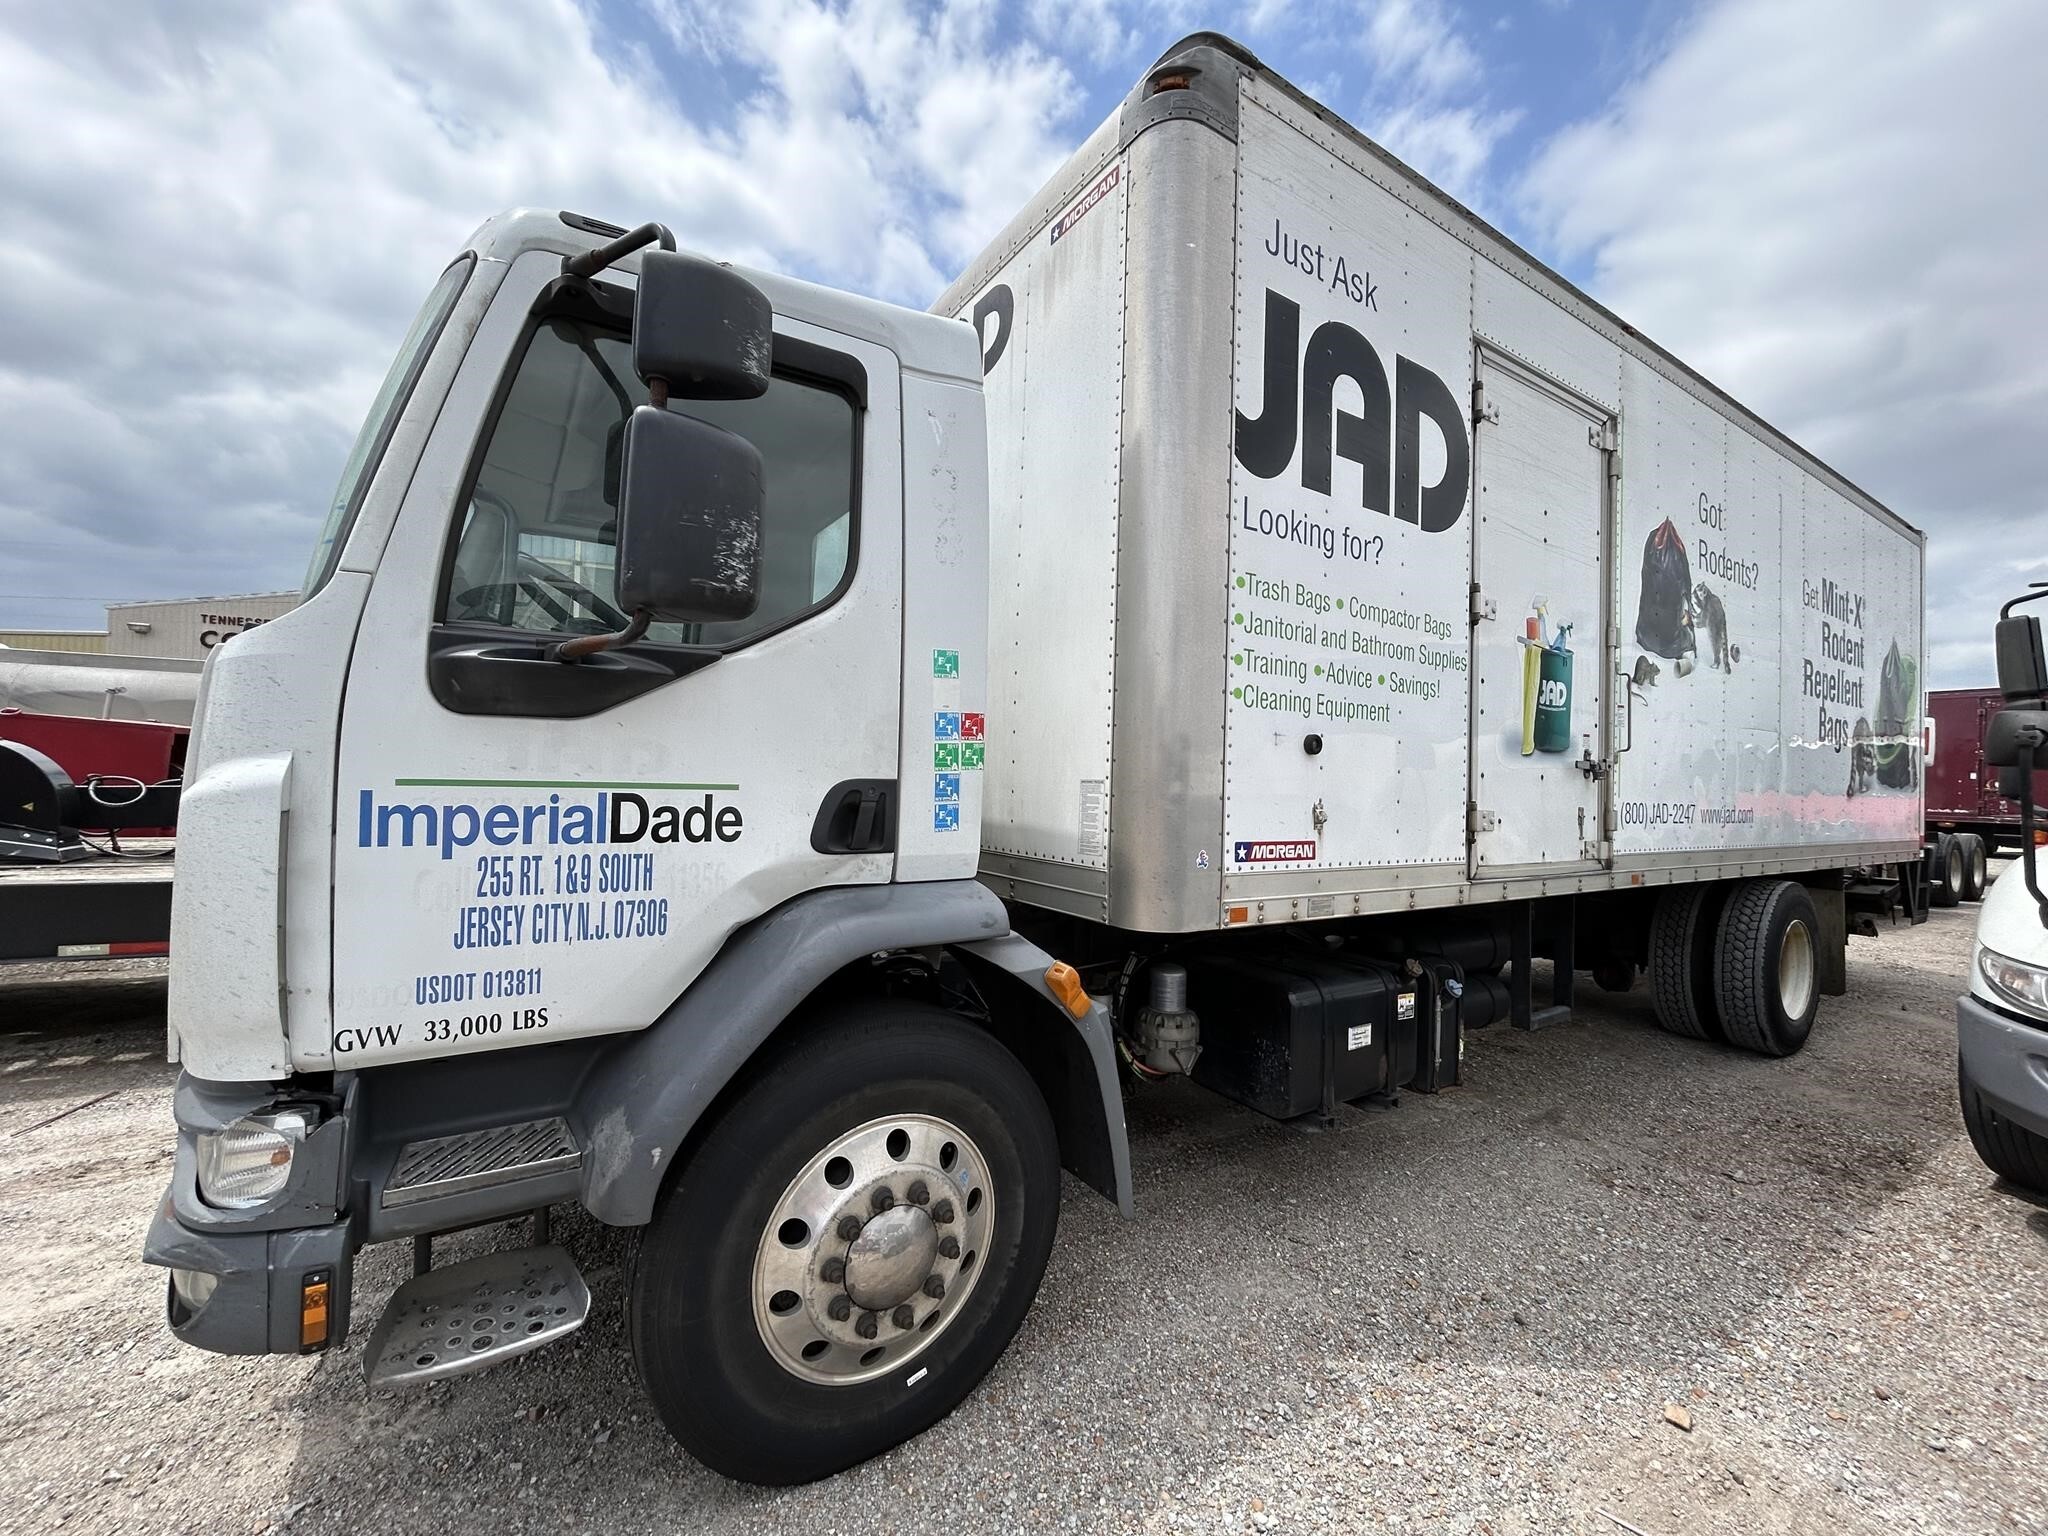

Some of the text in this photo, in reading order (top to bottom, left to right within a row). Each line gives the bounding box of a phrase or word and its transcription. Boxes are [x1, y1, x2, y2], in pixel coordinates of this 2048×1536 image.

[1062, 171, 1117, 232] MORGAN
[1265, 218, 1378, 312] Just Ask
[1234, 287, 1470, 533] JAD
[1243, 495, 1384, 565] Looking for?
[1698, 492, 1723, 531] Got
[1698, 538, 1759, 591] Rodents?
[1245, 572, 1452, 640] Trash Bags Compactor Bags
[1802, 578, 1820, 611] Get
[200, 614, 272, 627] TENNESS
[1244, 611, 1468, 672] Janitorial and Bathroom Supplies
[1821, 621, 1864, 670] Rodent
[1244, 648, 1441, 700] Training Advice Savings!
[1540, 679, 1567, 706] JAD
[1802, 658, 1863, 709] Repellent
[1243, 684, 1390, 723] Cleaning Equipment
[1818, 706, 1849, 753] Bags
[358, 790, 743, 860] ImperialDade
[1620, 802, 1754, 830] (800) JAD-2247 www.jad.com
[477, 855, 514, 898] 255
[519, 854, 545, 896] RT.
[554, 853, 591, 895] 1&9
[599, 853, 654, 893] SOUTH
[1250, 844, 1314, 860] MORGAN
[453, 898, 668, 950] JERSEY CITY, N.J. 07306
[415, 972, 477, 1006] USDOT
[483, 968, 542, 999] 013811
[334, 1007, 549, 1053] GVW 33,000 LBS
